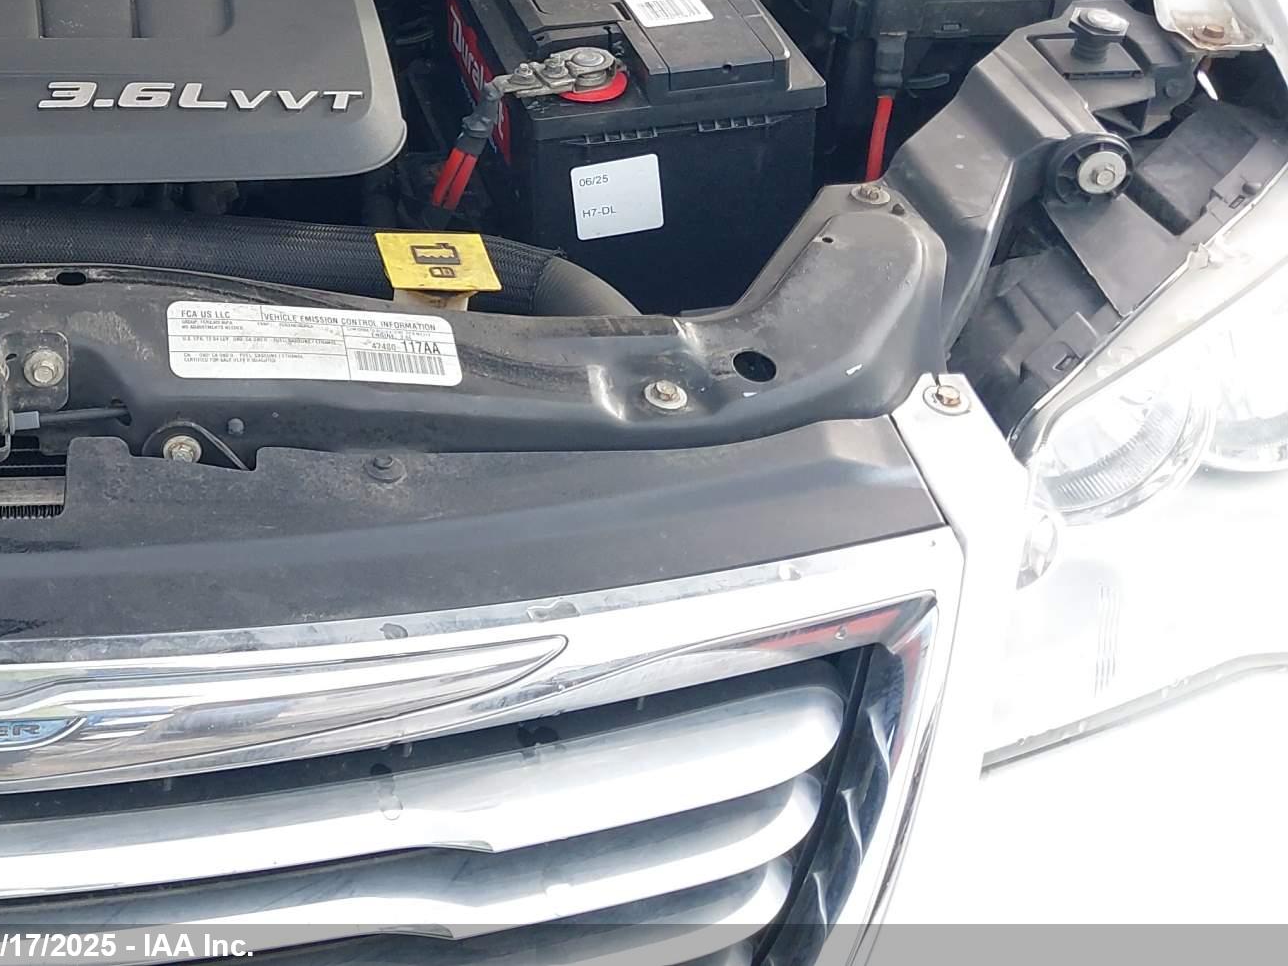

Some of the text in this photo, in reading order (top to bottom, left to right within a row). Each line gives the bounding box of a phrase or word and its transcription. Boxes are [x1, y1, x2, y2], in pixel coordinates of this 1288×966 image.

[579, 175, 609, 187] 06/25
[582, 206, 617, 218] H7-DL
[181, 310, 197, 318] FCA
[215, 311, 230, 319] LLC
[264, 314, 436, 331] VEHICLE EMISSION CONTROL INFORMATION
